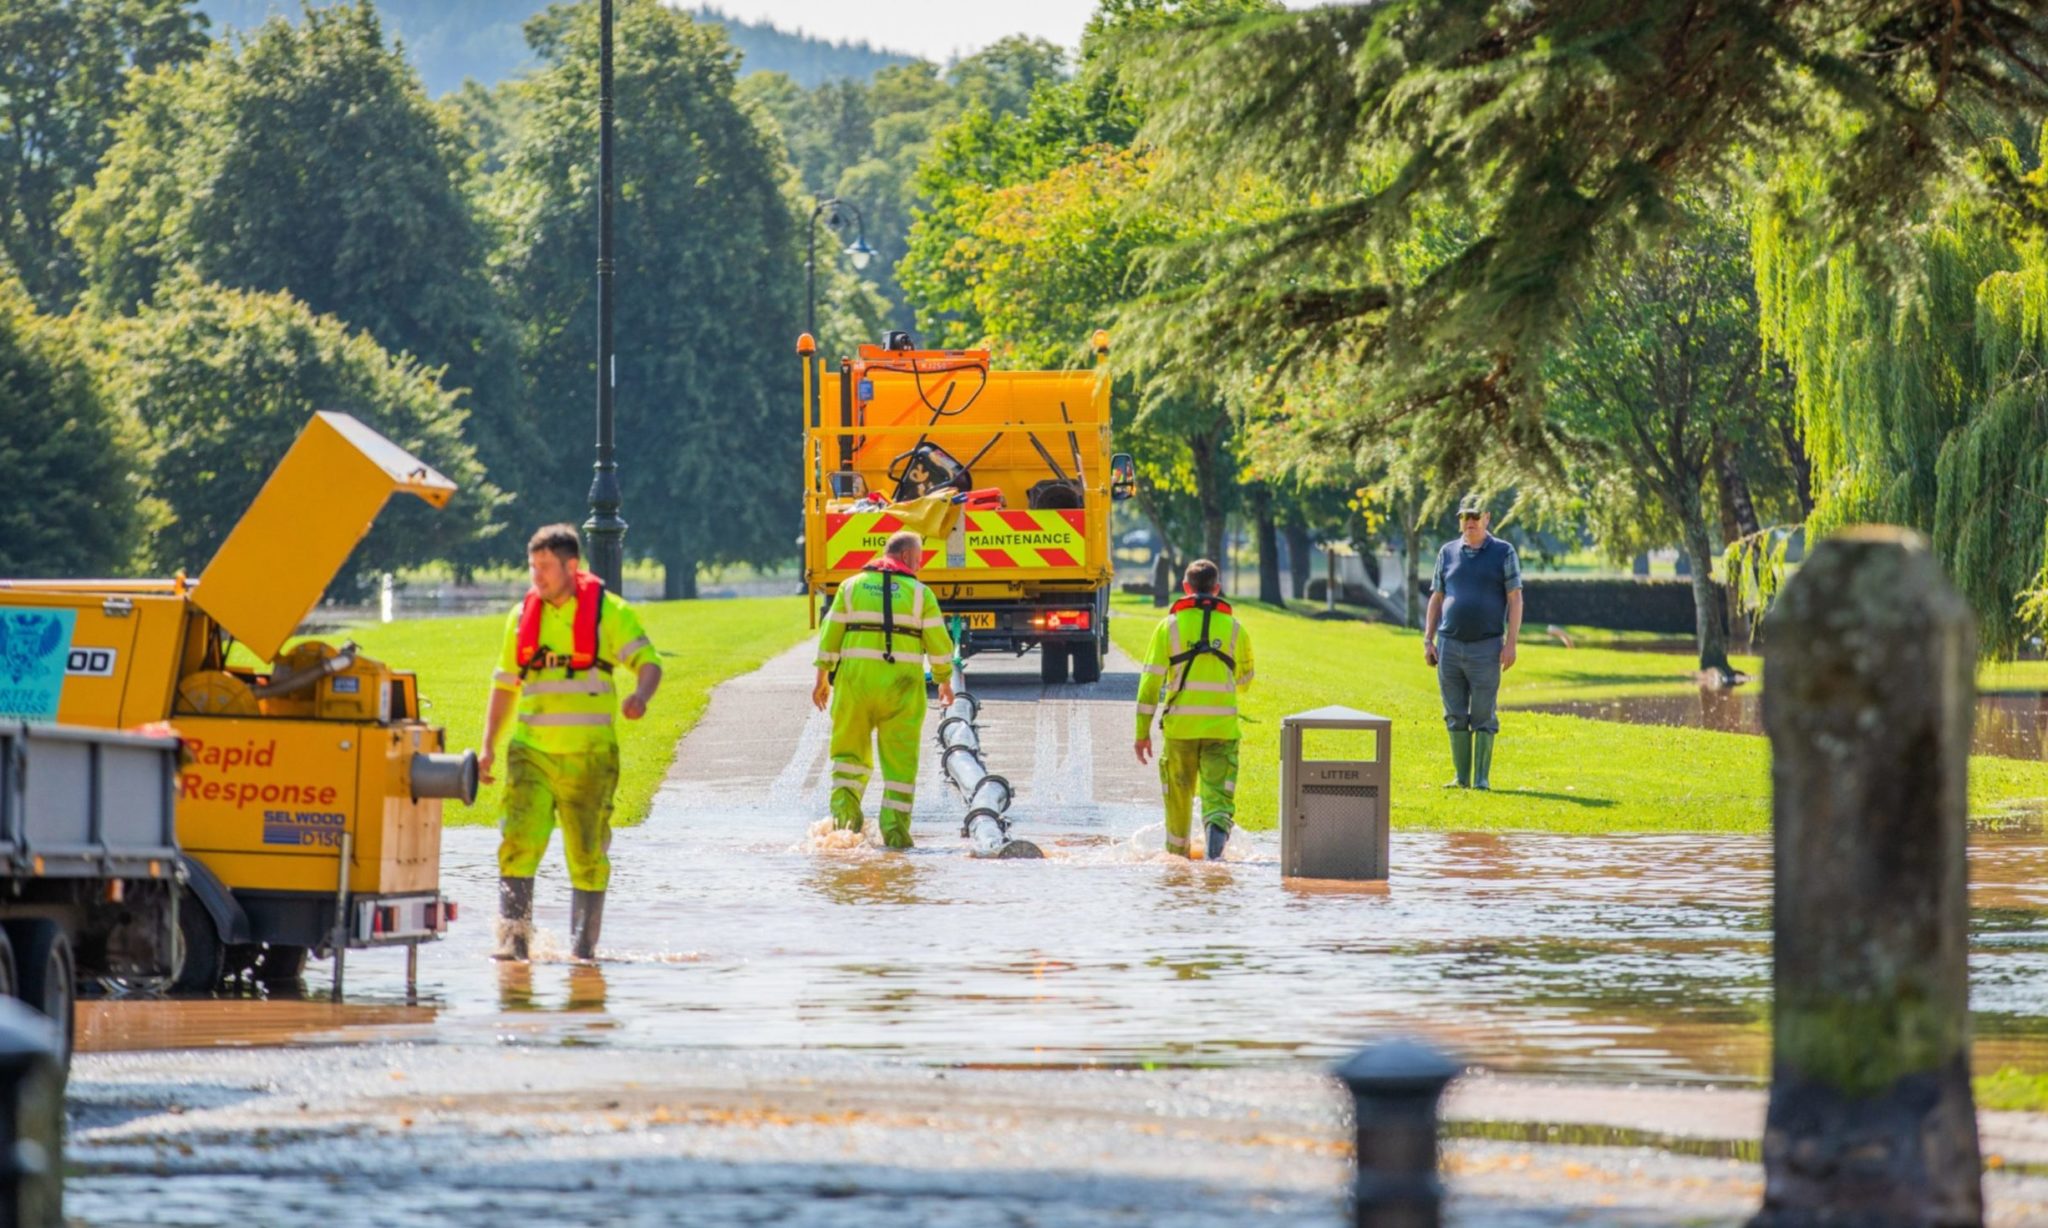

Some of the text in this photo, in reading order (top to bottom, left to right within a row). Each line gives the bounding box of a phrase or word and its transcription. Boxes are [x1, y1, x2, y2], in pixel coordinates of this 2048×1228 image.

[863, 533, 1071, 547] HIGY MAINTENANCE
[183, 739, 276, 773] Rapid
[1321, 770, 1359, 779] LITTER
[181, 774, 337, 810] Response
[264, 811, 345, 825] SELWOOD
